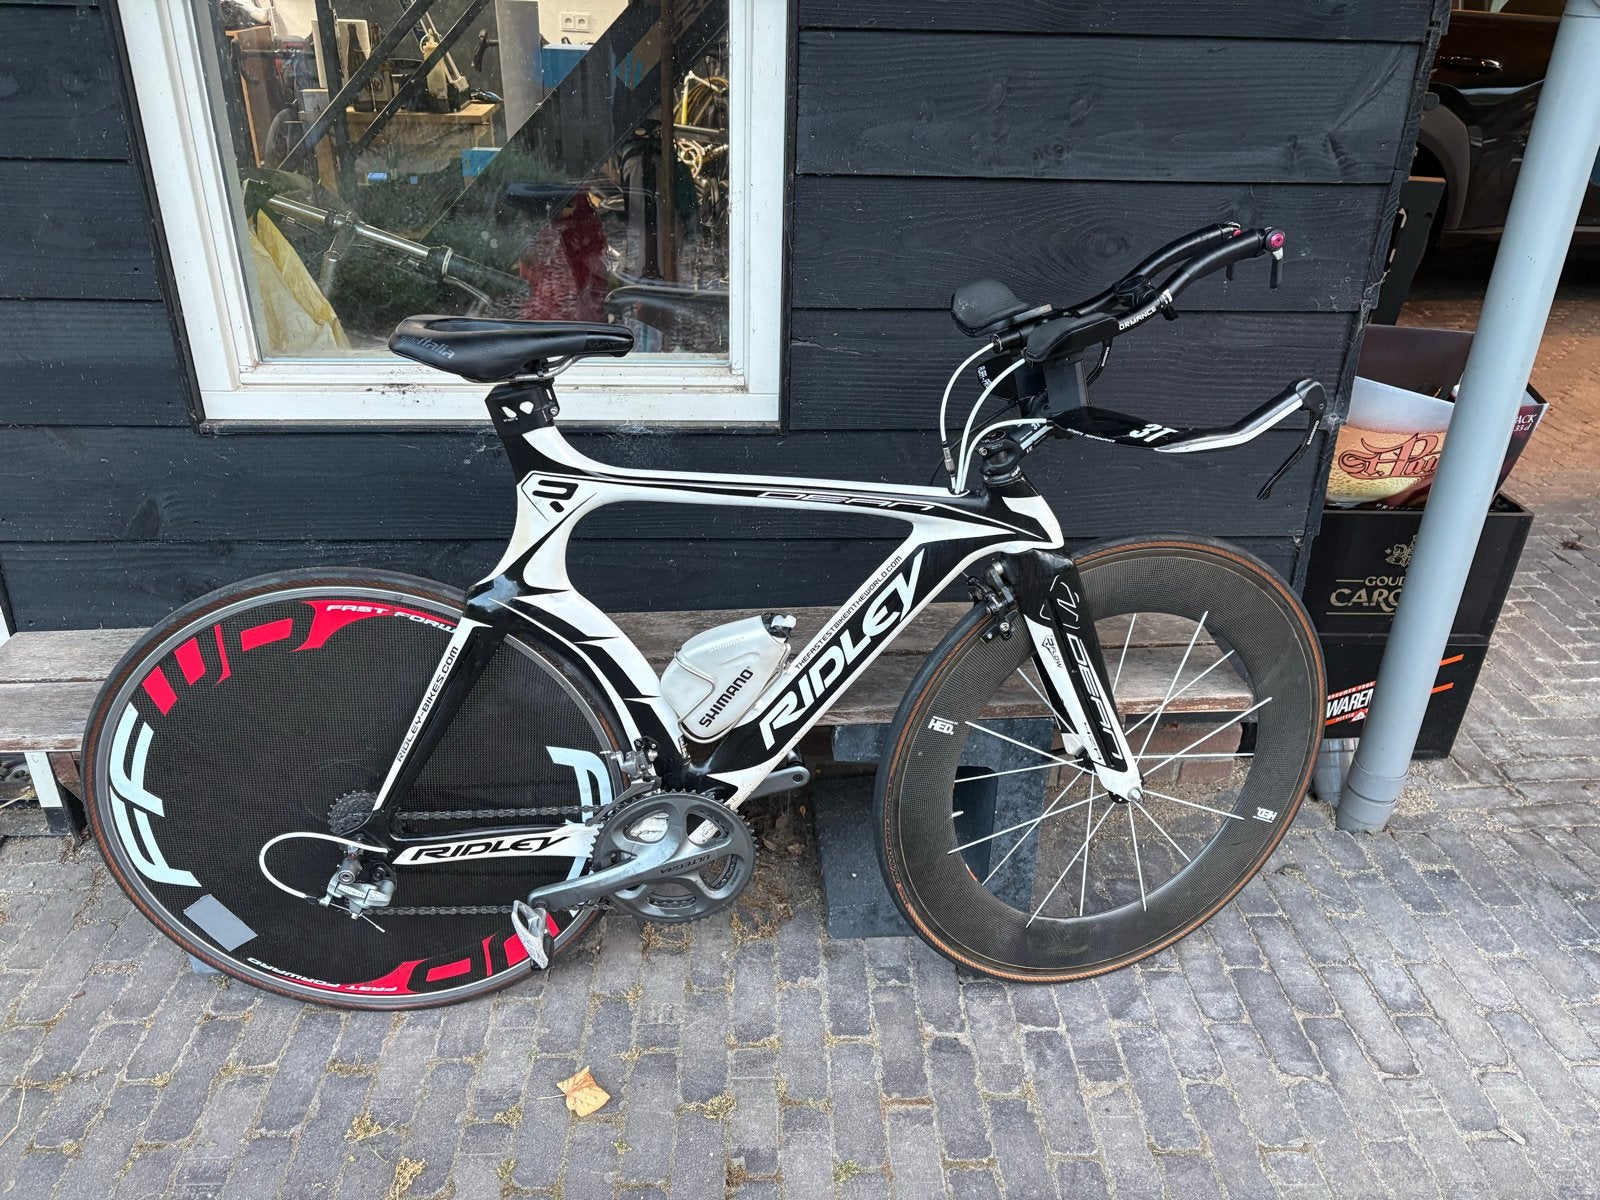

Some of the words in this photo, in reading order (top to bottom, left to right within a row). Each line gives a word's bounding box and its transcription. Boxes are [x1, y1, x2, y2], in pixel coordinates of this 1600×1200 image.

[1129, 423, 1169, 442] 3T
[757, 490, 936, 511] DEAN
[326, 604, 390, 614] FAST
[795, 555, 903, 670] THEFASTESTBIKEINTHEWORLD.COM
[758, 548, 925, 750] RIDLEY
[396, 646, 460, 763] RIDLEY-BIKES.COM
[698, 667, 754, 728] SHIMANO
[1066, 632, 1124, 760] DEAN
[410, 836, 572, 861] RIDLEY
[659, 854, 710, 874] ULTEGRA
[246, 956, 342, 988] FORWARD
[344, 985, 399, 993] FAST
